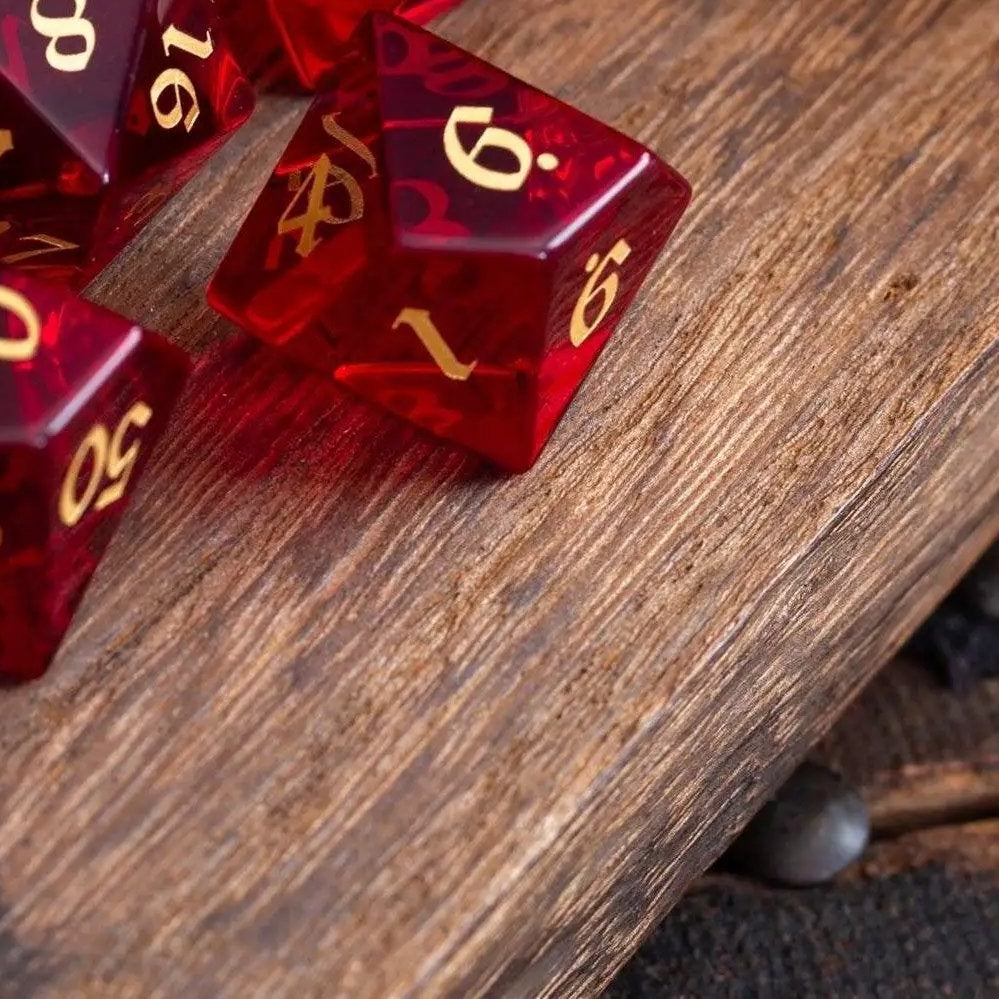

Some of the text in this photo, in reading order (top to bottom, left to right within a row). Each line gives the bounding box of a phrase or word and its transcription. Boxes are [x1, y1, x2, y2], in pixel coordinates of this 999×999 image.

[149, 24, 215, 133] 16
[392, 307, 478, 381] 1
[58, 402, 153, 527] 50
